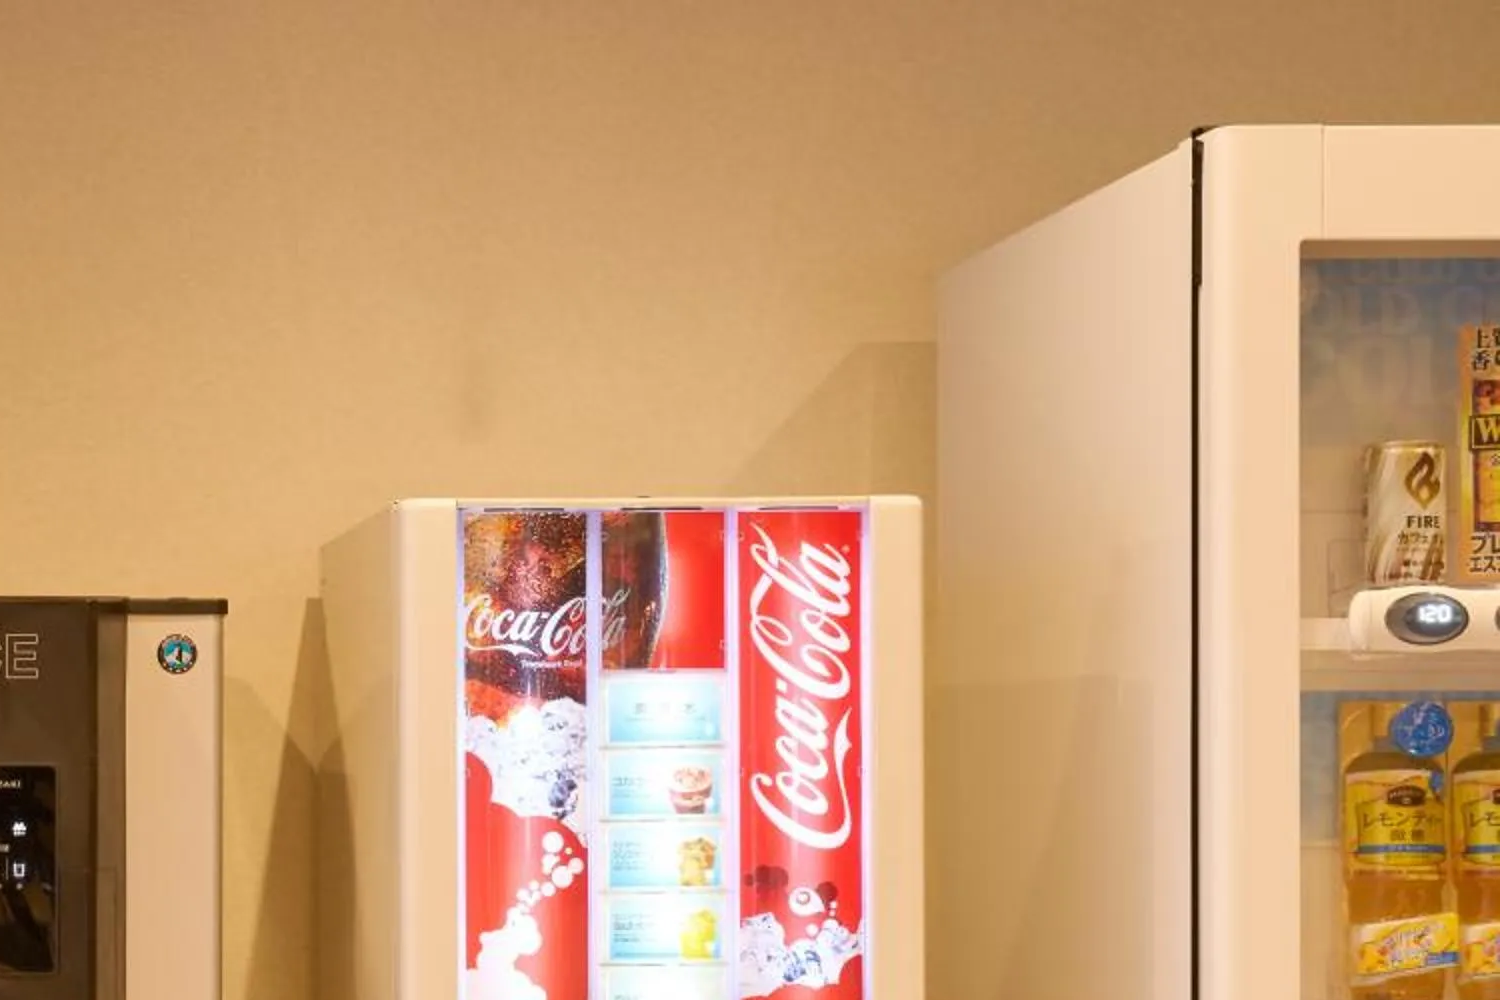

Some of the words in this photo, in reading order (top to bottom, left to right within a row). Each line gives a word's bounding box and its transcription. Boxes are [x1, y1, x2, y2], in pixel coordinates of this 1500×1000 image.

[1406, 516, 1441, 529] FIRE
[1417, 604, 1452, 623] 120
[748, 521, 854, 850] Coca-Cola
